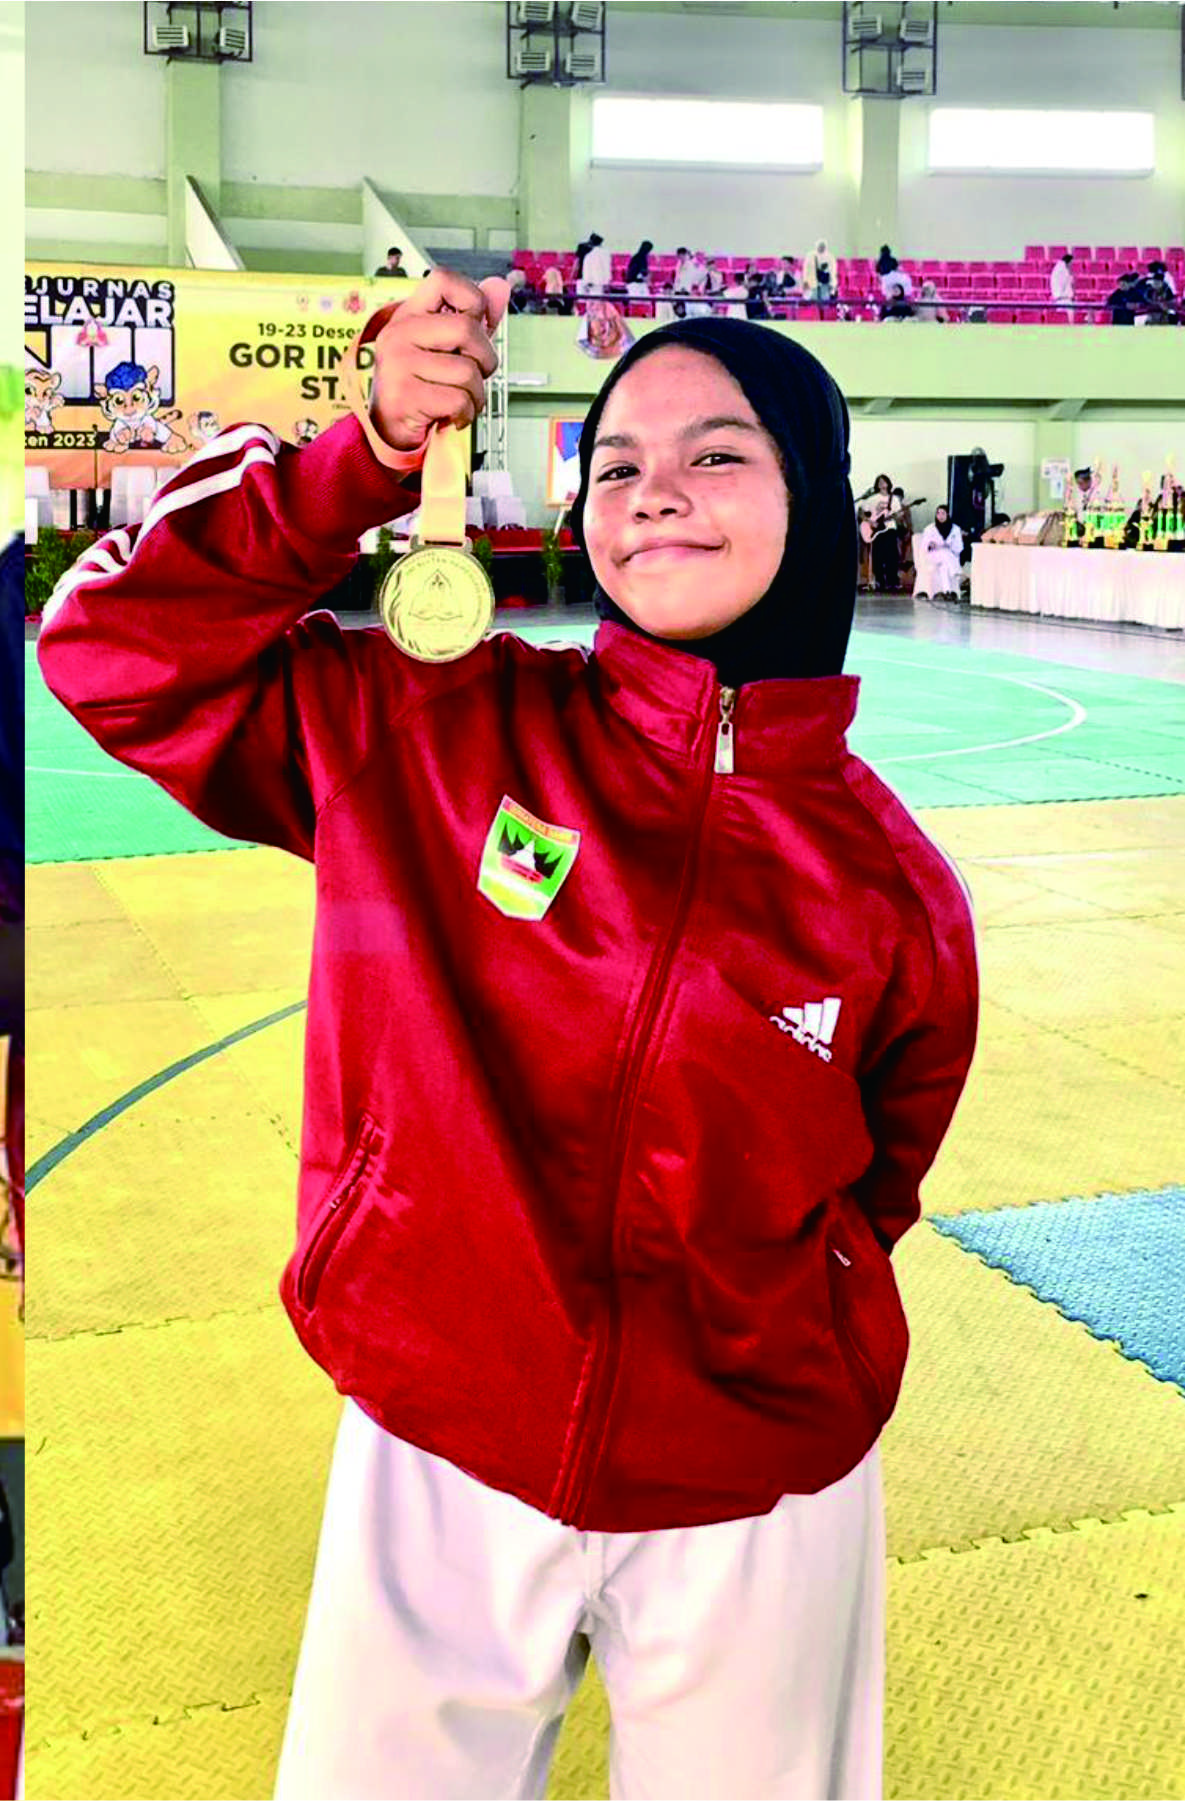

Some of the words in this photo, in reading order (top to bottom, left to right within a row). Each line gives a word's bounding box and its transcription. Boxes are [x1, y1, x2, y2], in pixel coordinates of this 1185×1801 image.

[27, 277, 172, 300] JURNAS
[258, 322, 306, 338] 19-23
[312, 324, 362, 340] Dese
[229, 342, 305, 369] GOR
[53, 433, 96, 447] 2023
